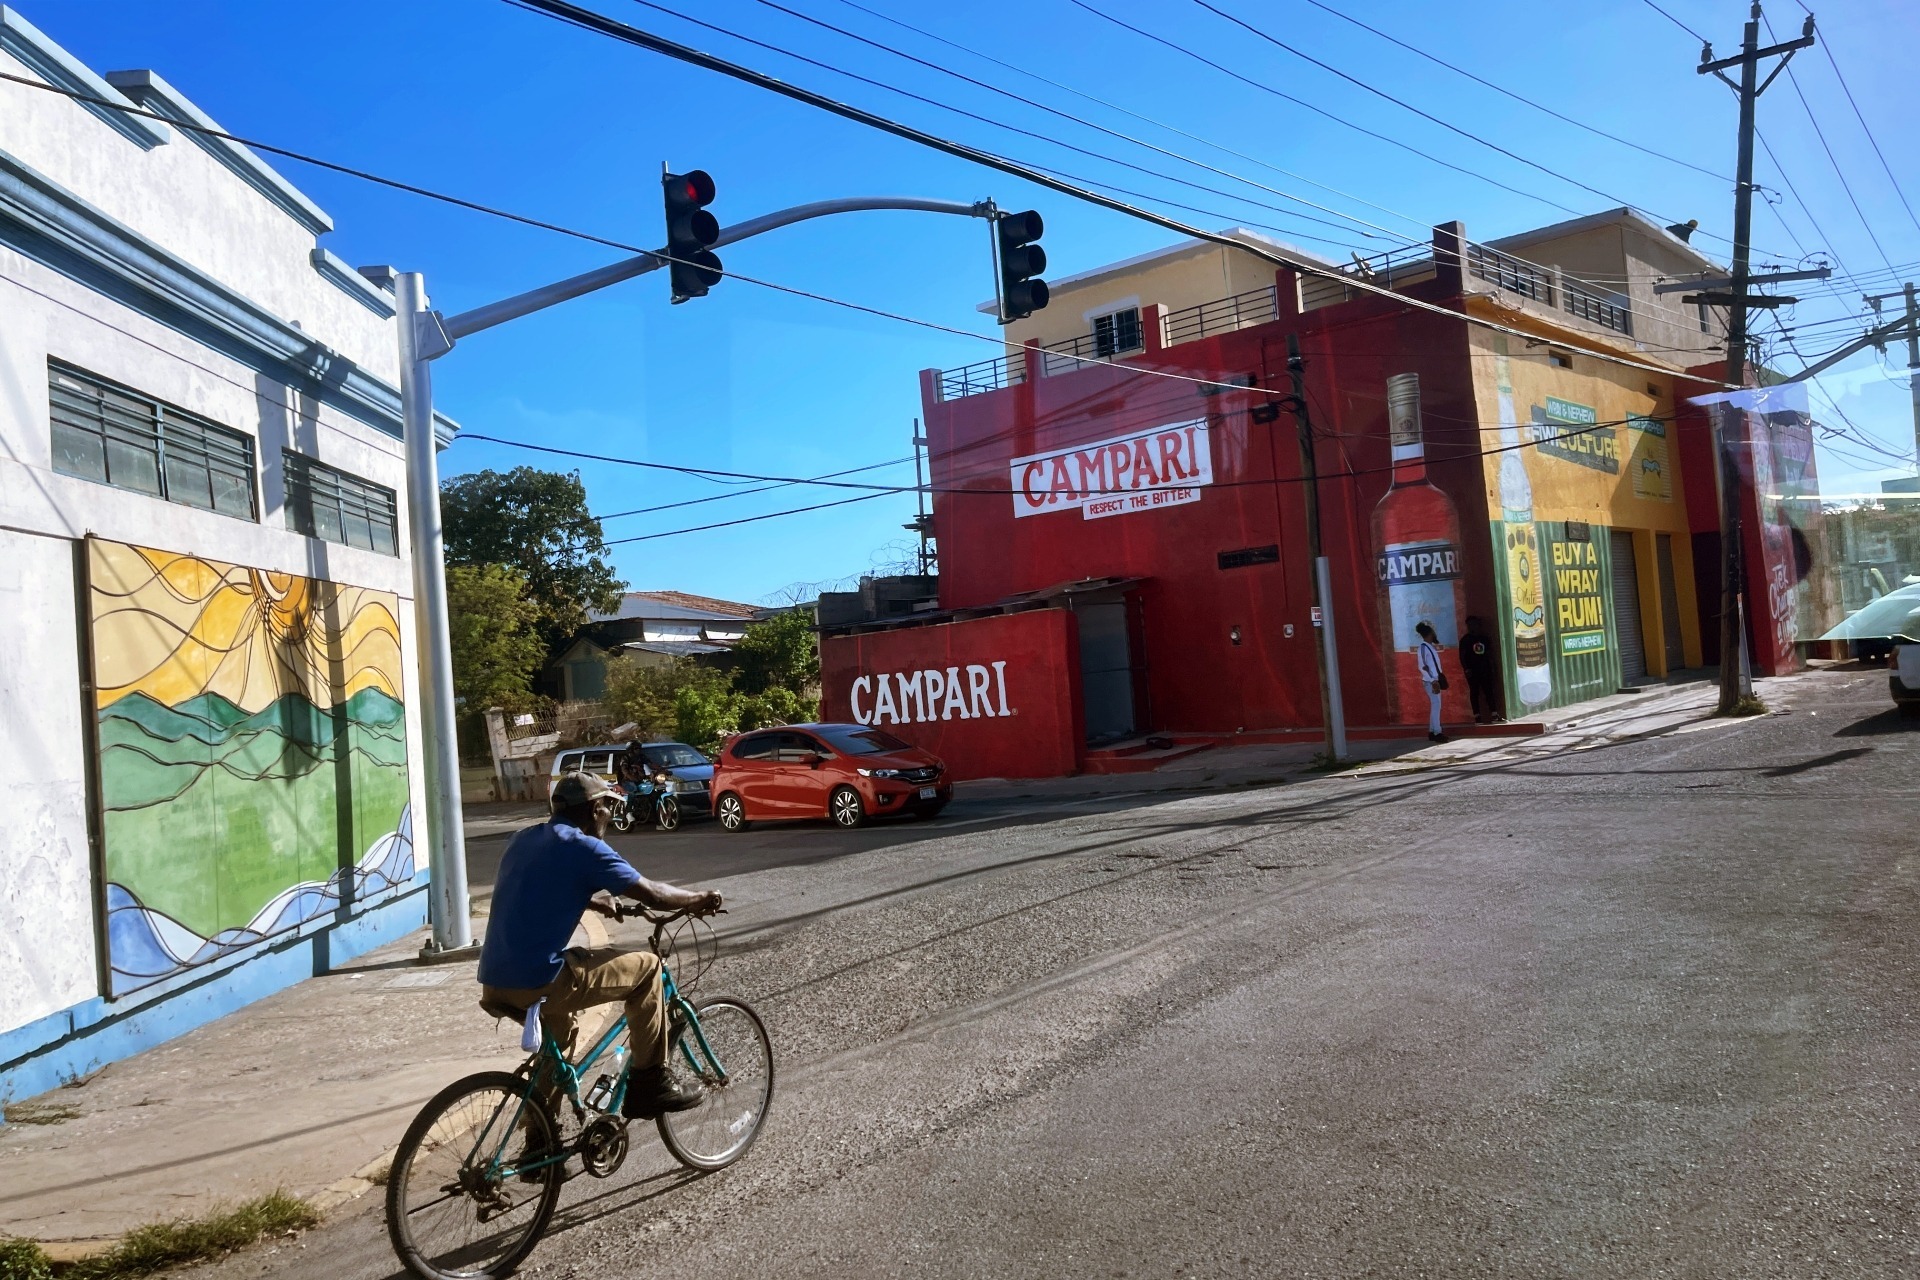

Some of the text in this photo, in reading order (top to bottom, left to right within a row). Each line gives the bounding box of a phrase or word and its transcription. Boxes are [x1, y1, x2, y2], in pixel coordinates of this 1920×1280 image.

[1022, 427, 1200, 508] CAMPARI
[1089, 488, 1192, 515] RESPECT THE BITTER
[1552, 542, 1597, 566] BUY A
[1556, 569, 1599, 594] WRAY
[1558, 596, 1604, 628] RUM!
[850, 660, 1012, 726] CAMPARI
